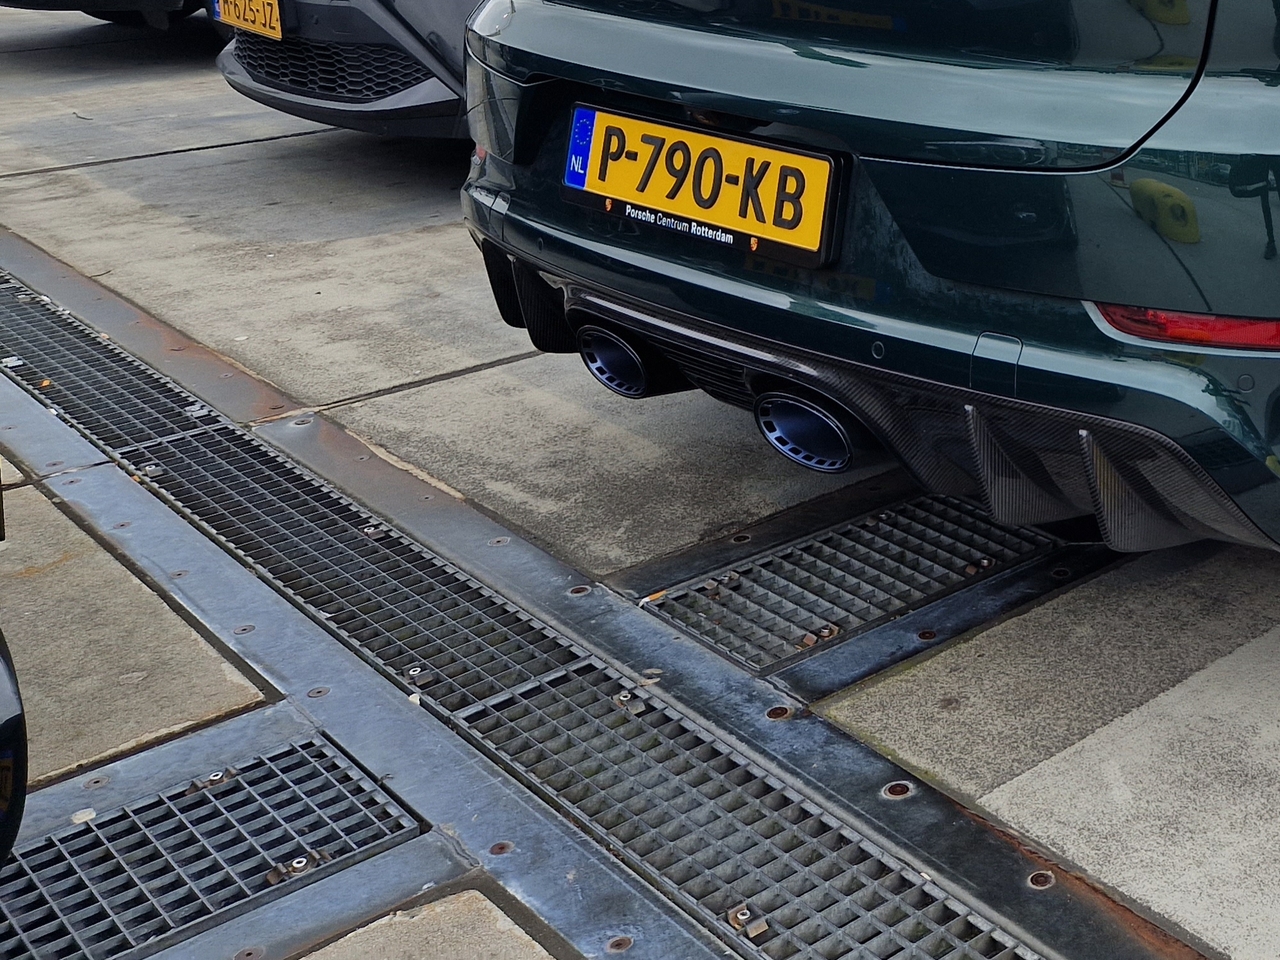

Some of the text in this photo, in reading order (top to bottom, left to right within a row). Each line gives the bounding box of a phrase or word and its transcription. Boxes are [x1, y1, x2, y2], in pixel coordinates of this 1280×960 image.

[570, 125, 806, 230] NL P-790-KB
[625, 204, 734, 245] Porsche Centrum Rotterdam
